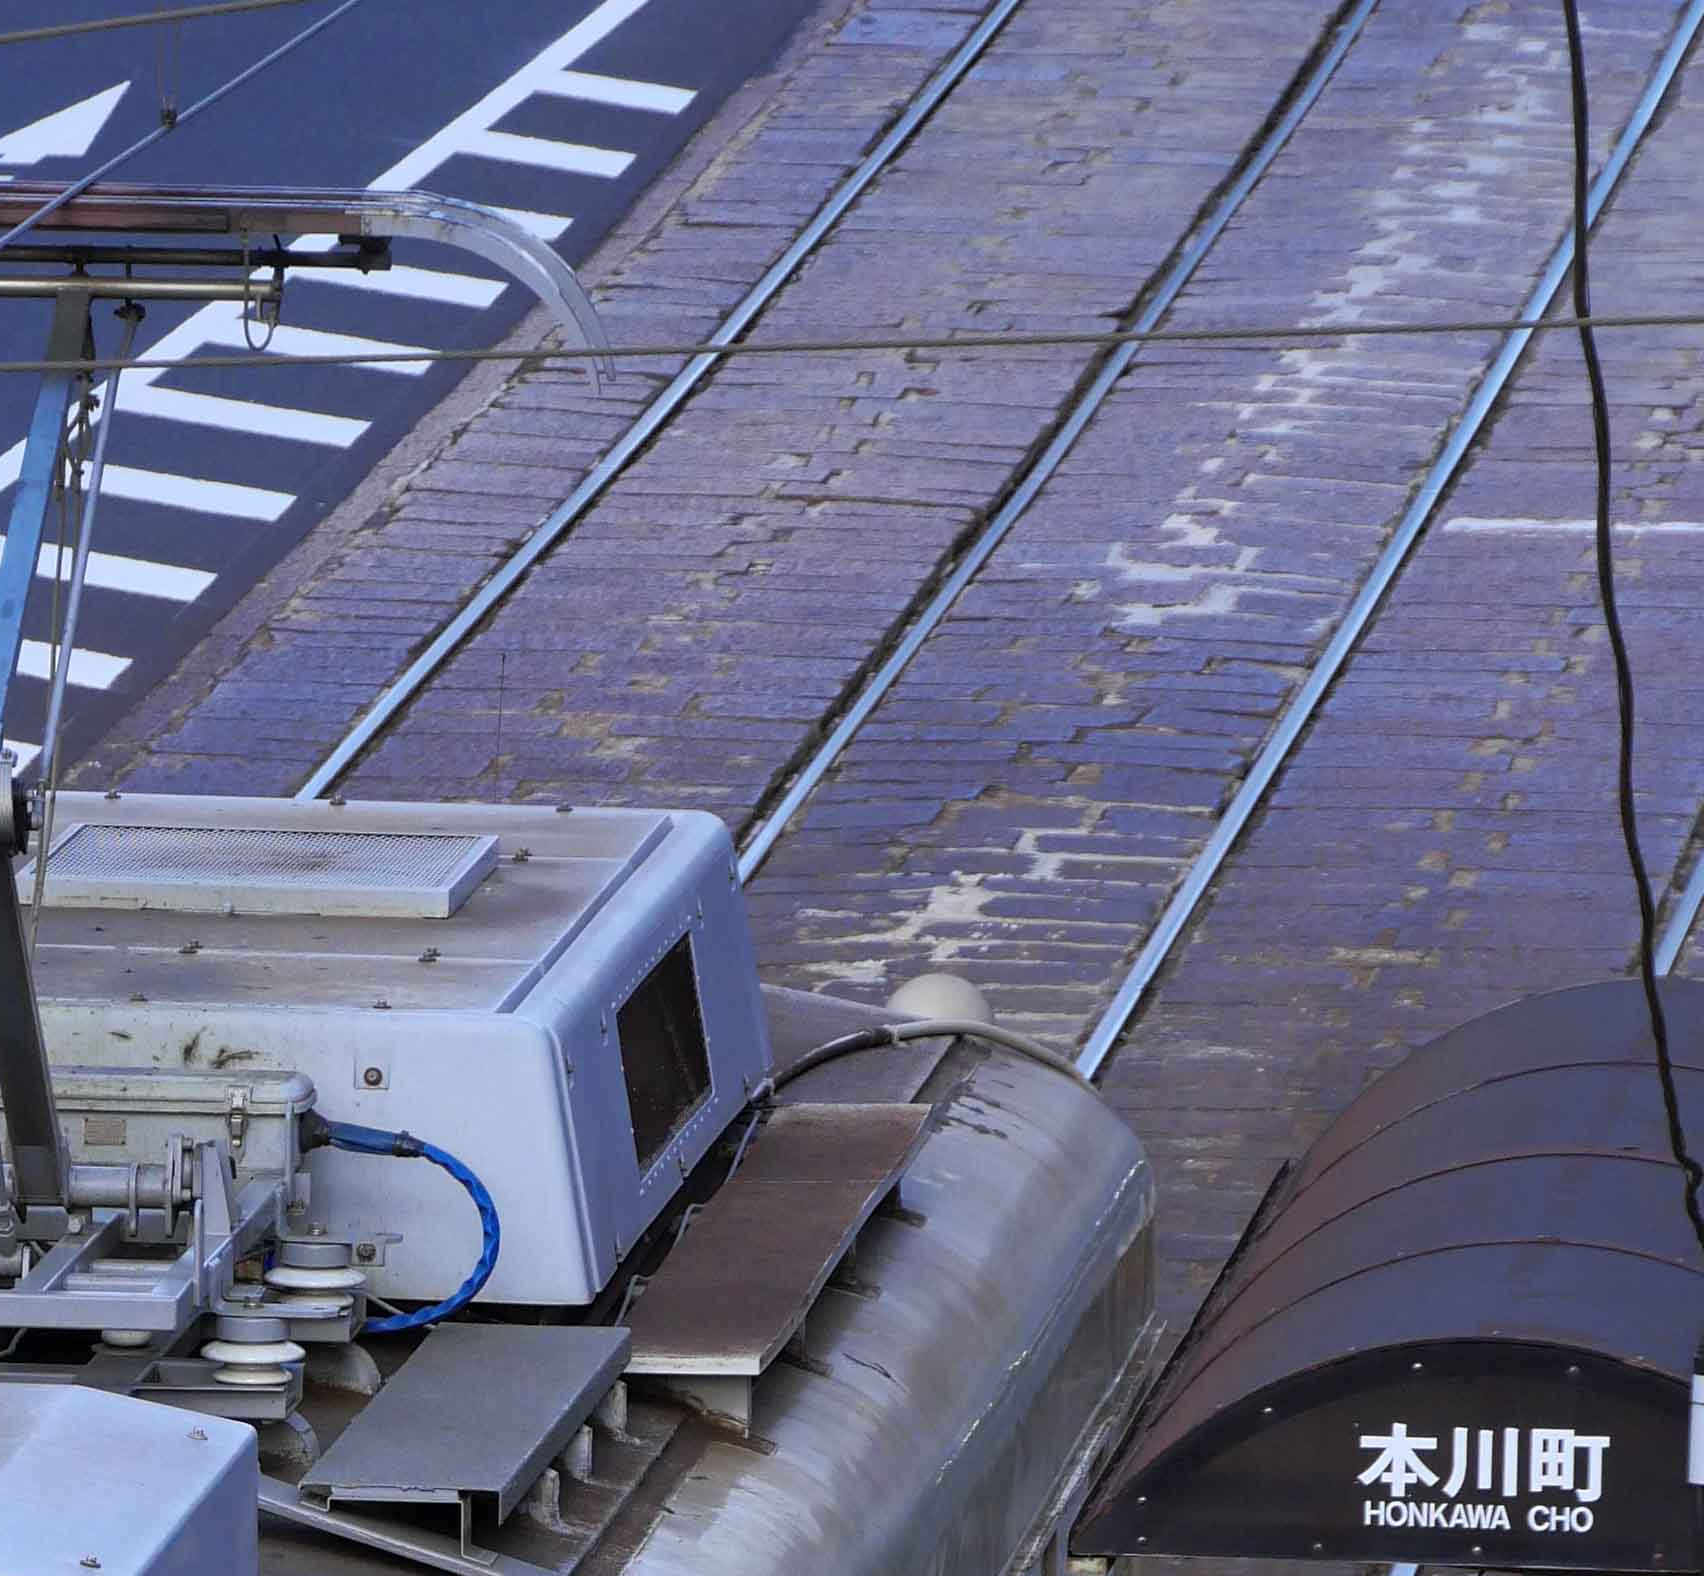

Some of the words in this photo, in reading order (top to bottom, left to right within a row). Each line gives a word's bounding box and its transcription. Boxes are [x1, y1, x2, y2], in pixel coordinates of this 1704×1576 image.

[1358, 1423, 1610, 1501] 本川町
[1363, 1501, 1511, 1531] HONKAWA
[1528, 1504, 1594, 1533] CHO
